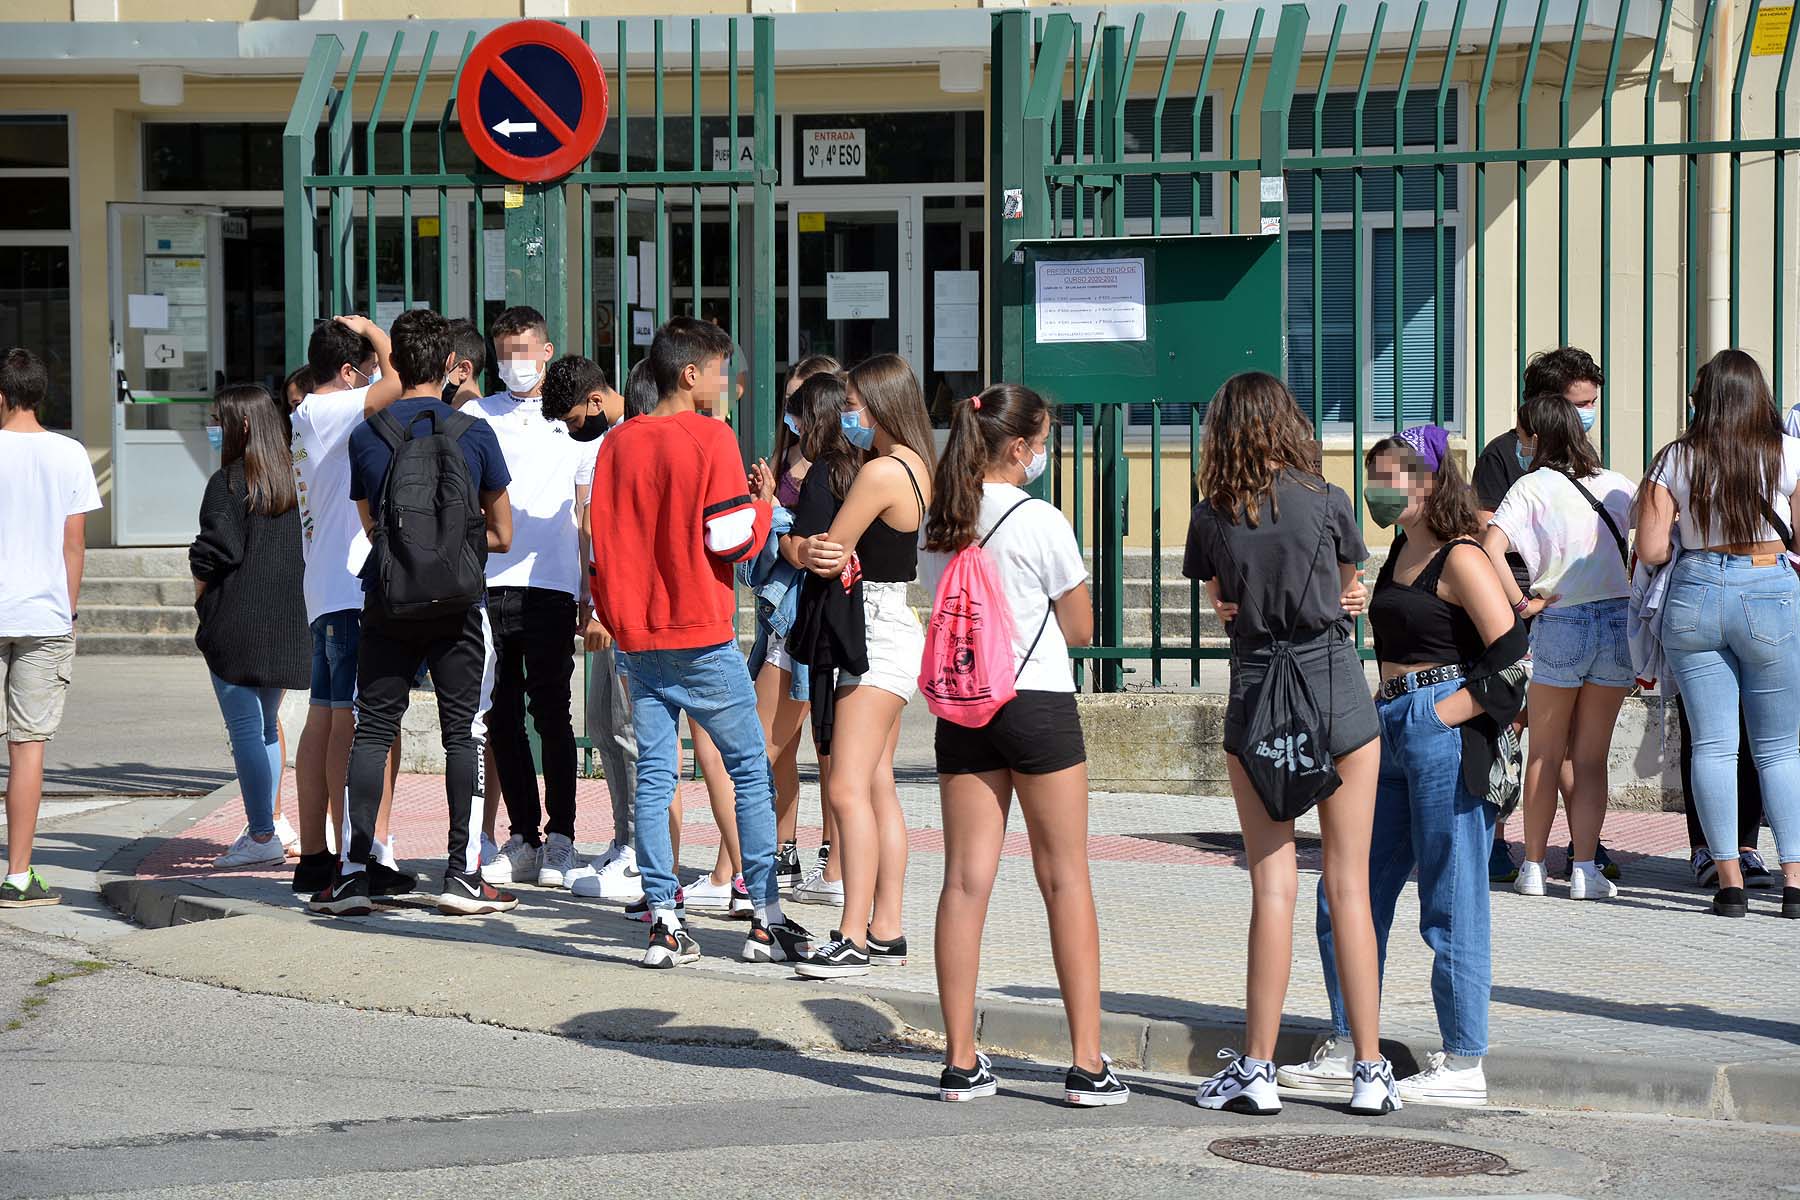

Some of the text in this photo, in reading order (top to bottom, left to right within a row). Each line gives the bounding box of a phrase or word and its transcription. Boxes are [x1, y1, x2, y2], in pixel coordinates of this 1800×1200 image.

[815, 131, 855, 140] ENTRADA
[740, 146, 753, 160] A
[809, 144, 819, 166] 3º
[826, 144, 836, 166] 4º
[839, 144, 861, 165] ESO
[1047, 267, 1095, 275] PRESENTACIÓN
[1106, 266, 1126, 274] INICIO
[1064, 275, 1118, 284] CURSO 2020-2021
